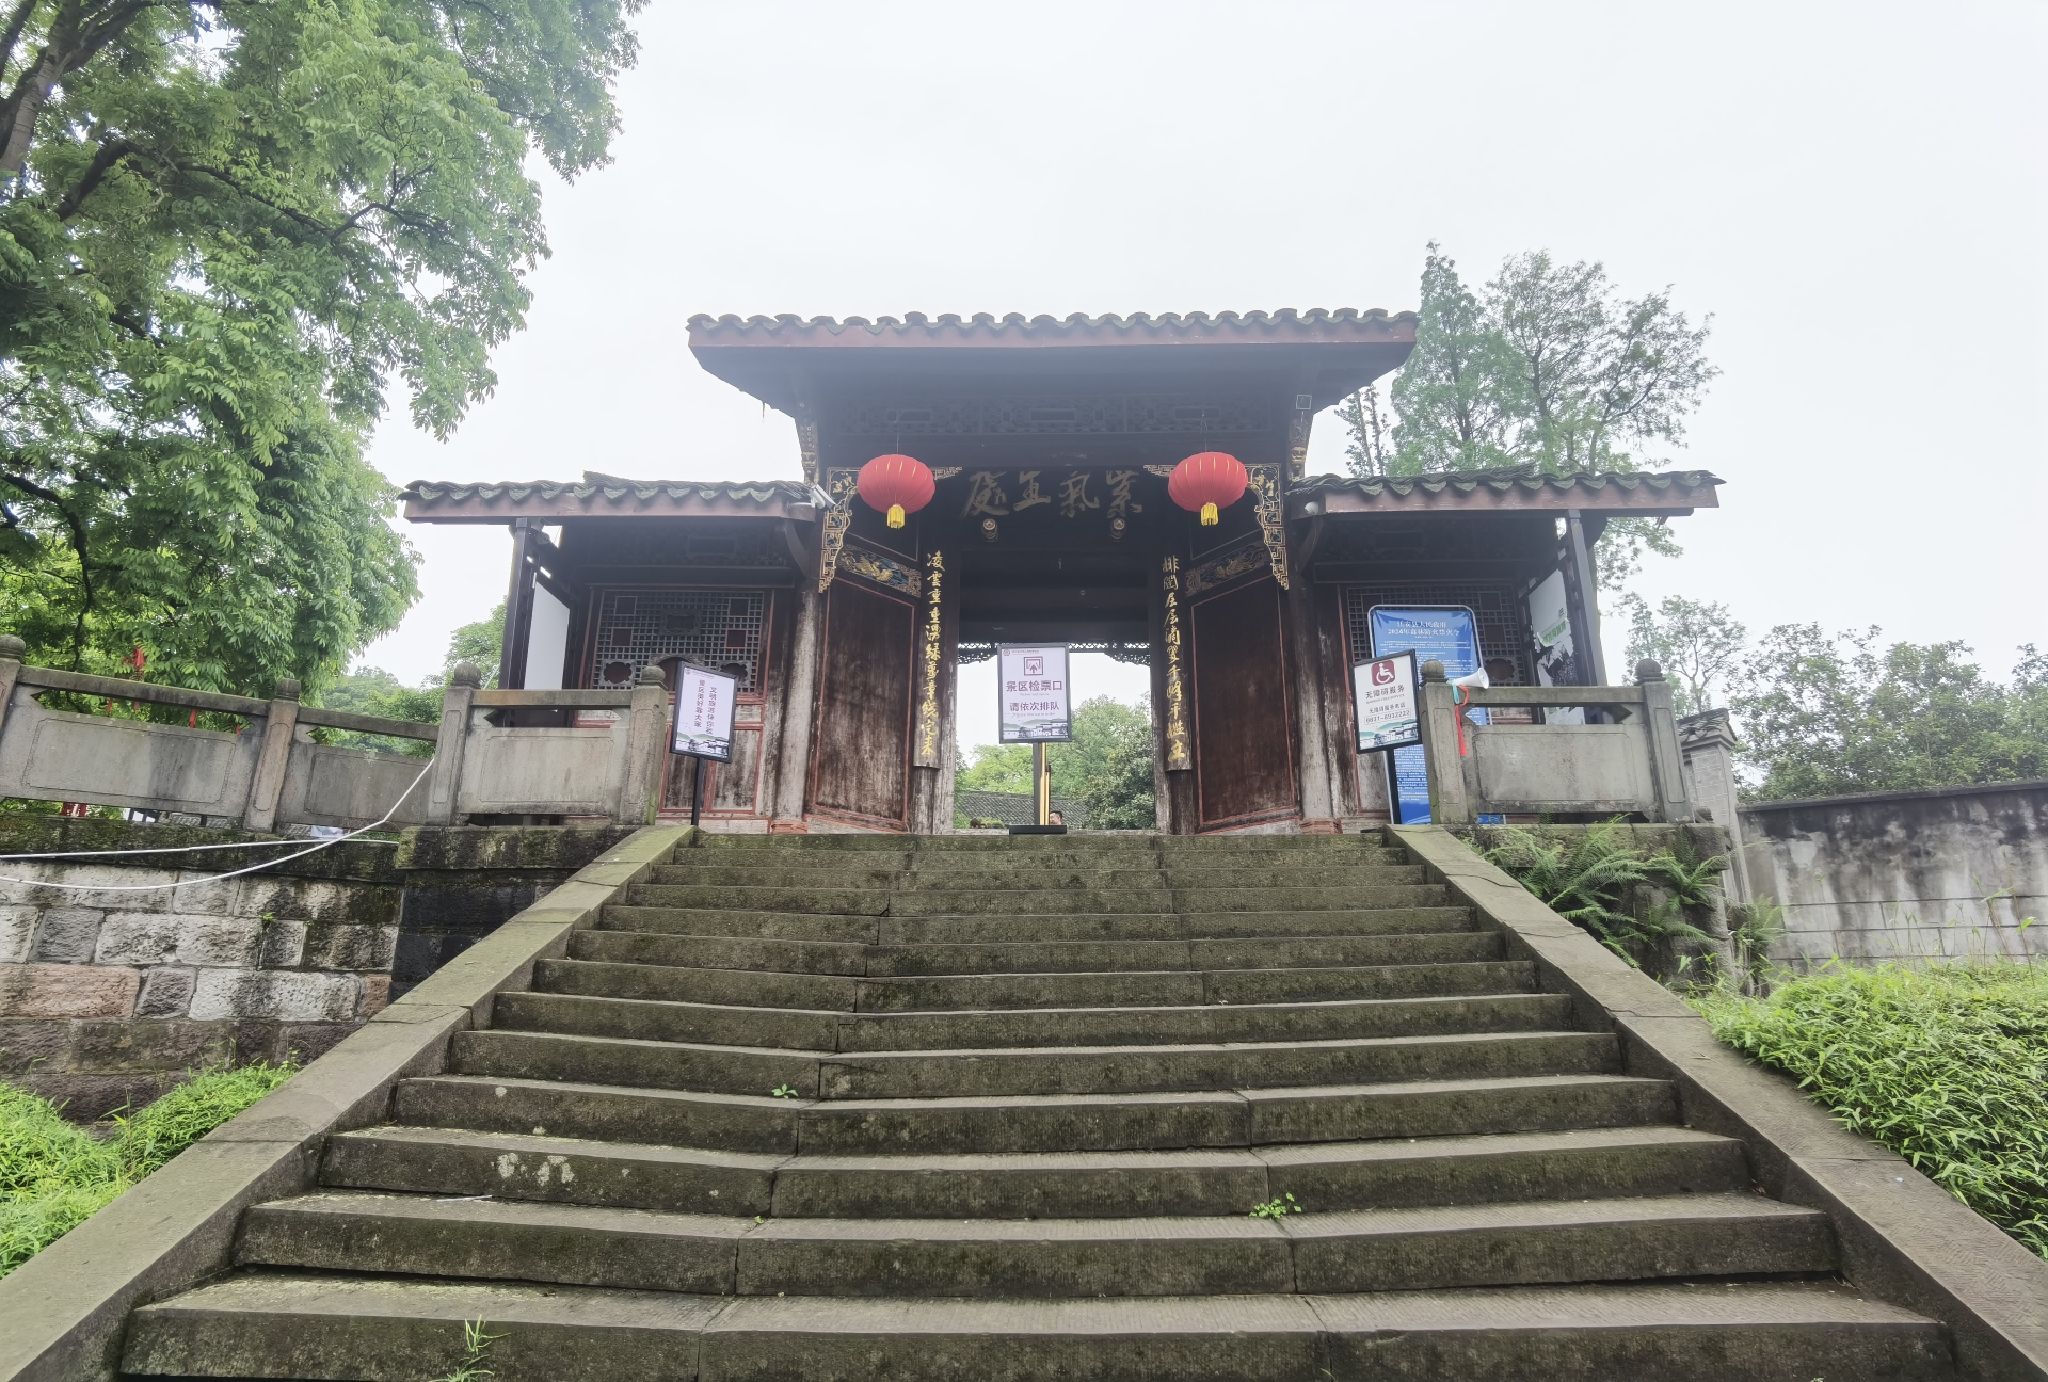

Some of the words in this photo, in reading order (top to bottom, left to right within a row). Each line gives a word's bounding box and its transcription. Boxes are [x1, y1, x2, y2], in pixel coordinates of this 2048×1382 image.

[1006, 680, 1063, 692] 景区检票口
[1365, 684, 1405, 699] 无障碍服务
[1009, 701, 1060, 712] 请依次排队
